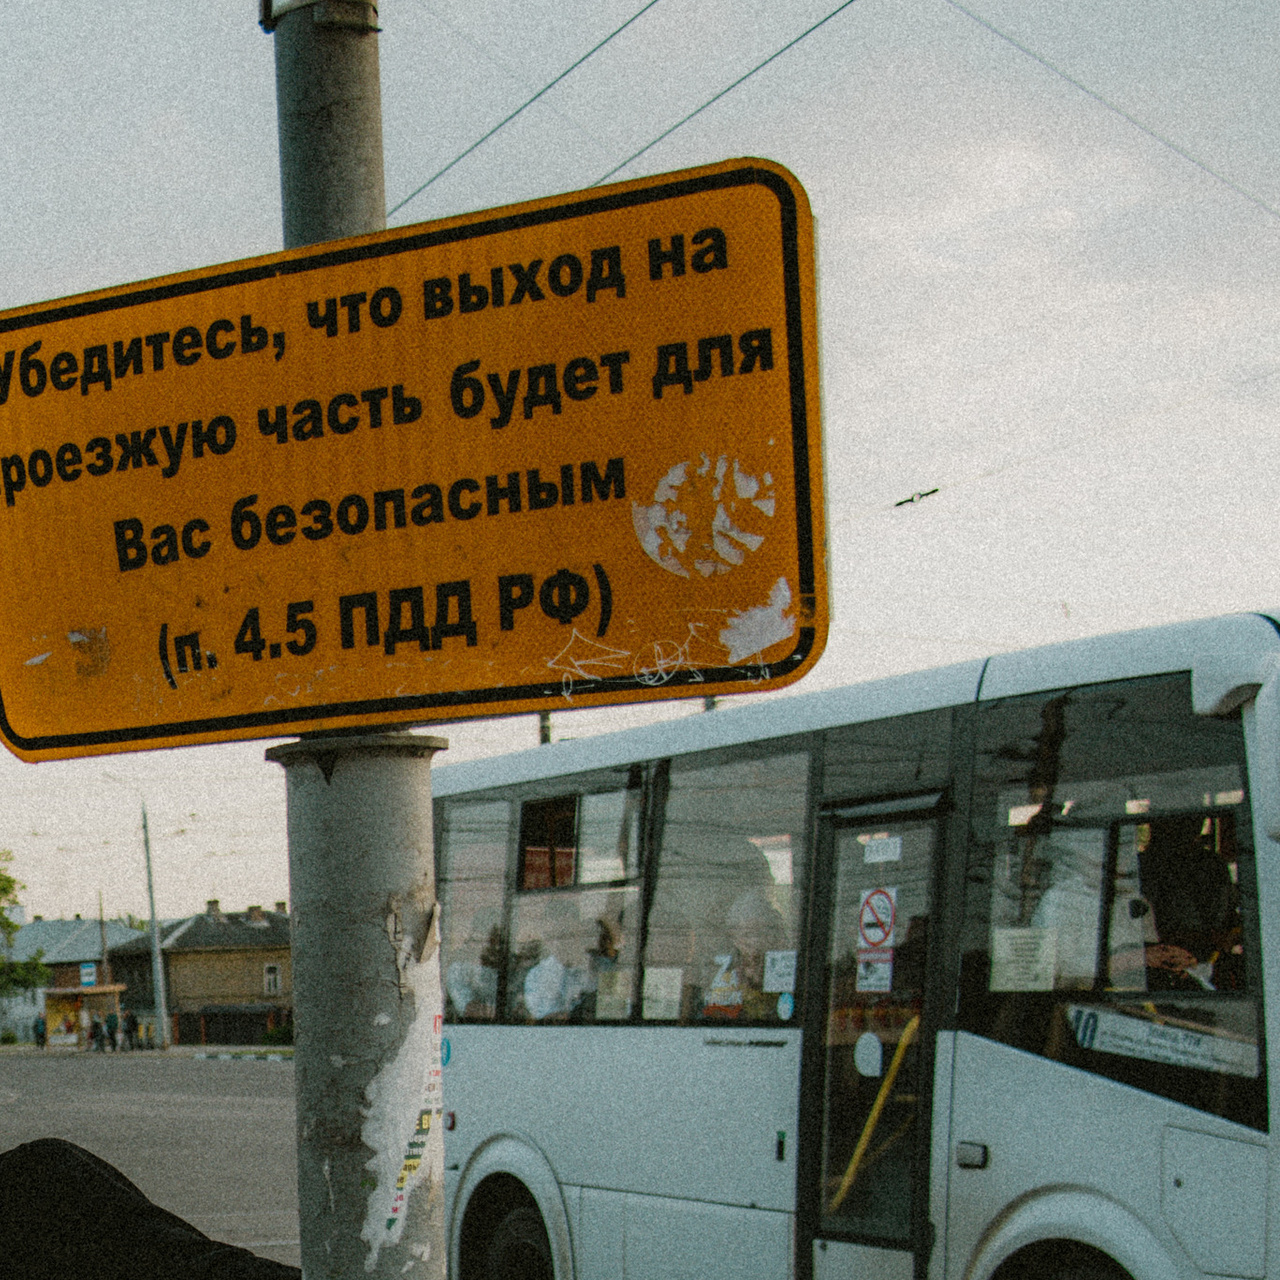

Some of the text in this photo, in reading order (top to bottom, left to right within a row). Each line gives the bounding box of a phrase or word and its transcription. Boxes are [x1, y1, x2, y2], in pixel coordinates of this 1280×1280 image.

[306, 285, 404, 338] что
[422, 244, 627, 321] выход
[647, 226, 729, 282] на
[256, 383, 424, 445] часть
[449, 349, 632, 430] будет
[651, 327, 775, 400] для
[113, 456, 627, 573] Вас безопасным
[158, 562, 614, 689] (п. 4.5 ПДД РФ)
